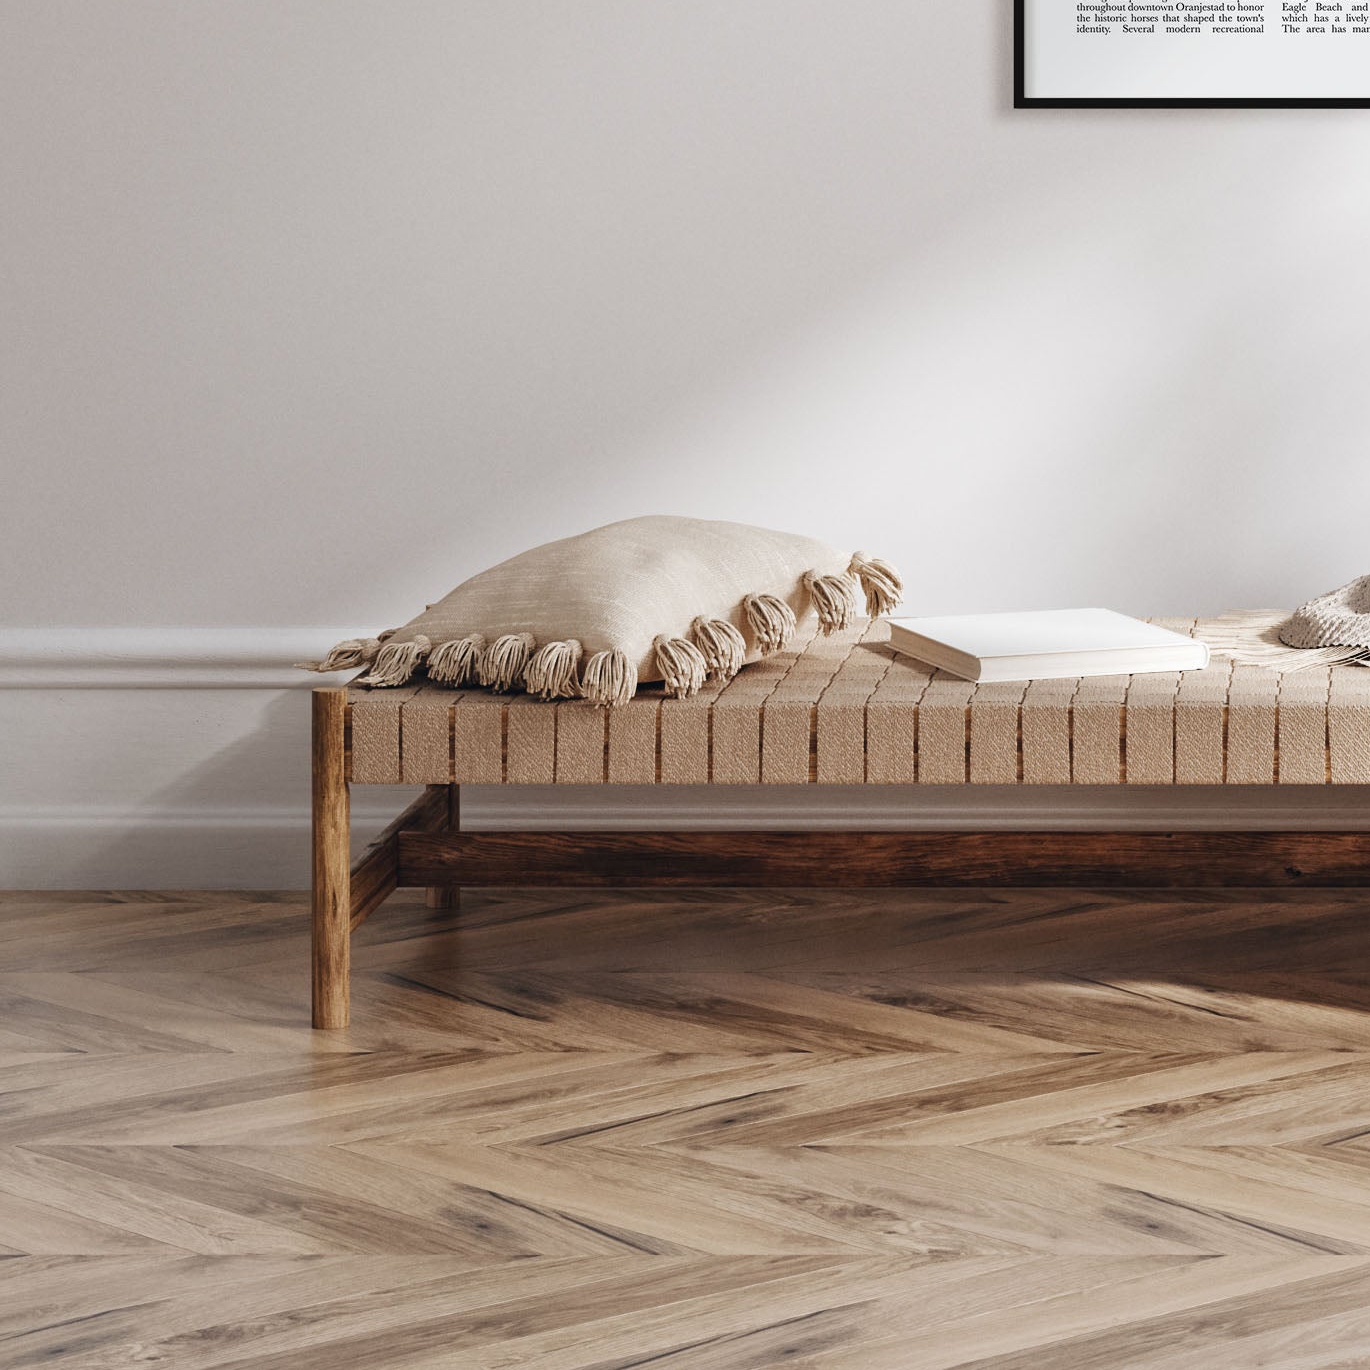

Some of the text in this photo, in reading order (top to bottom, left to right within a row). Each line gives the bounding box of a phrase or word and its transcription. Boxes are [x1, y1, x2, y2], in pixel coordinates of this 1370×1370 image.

[1076, 3, 1265, 13] throughout downtown Oranjestad to honor
[1281, 3, 1307, 13] Eagle
[1315, 3, 1343, 11] Beach
[1351, 3, 1368, 11] and
[1076, 24, 1264, 35] identity. Several modern recreational
[1281, 24, 1301, 33] The
[1331, 24, 1347, 33] has
